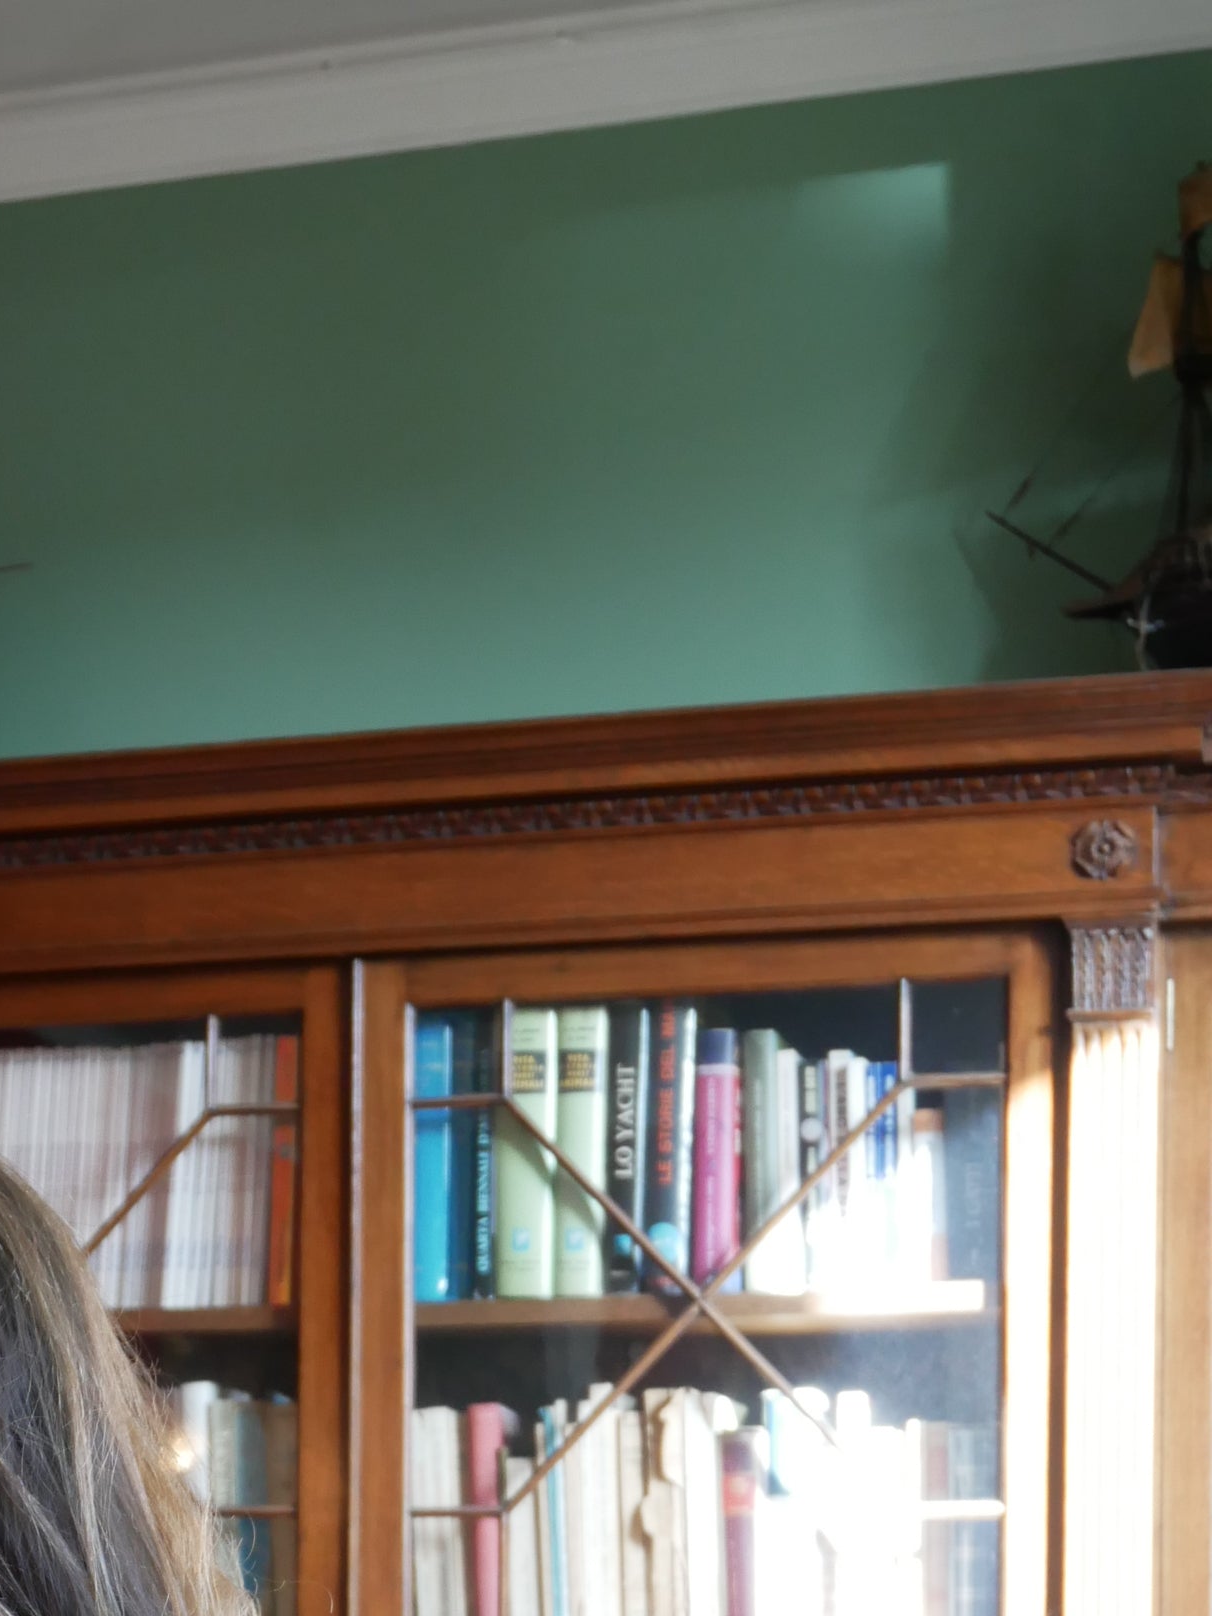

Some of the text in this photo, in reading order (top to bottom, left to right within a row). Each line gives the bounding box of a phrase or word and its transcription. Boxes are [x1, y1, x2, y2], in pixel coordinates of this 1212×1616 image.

[660, 1045, 675, 1082] DEL
[614, 1062, 636, 1180] LO YACHT
[657, 1087, 674, 1154] STORIE
[477, 1151, 491, 1213] BIENNALE
[657, 1160, 672, 1186] LE
[476, 1216, 490, 1274] QUARTA
